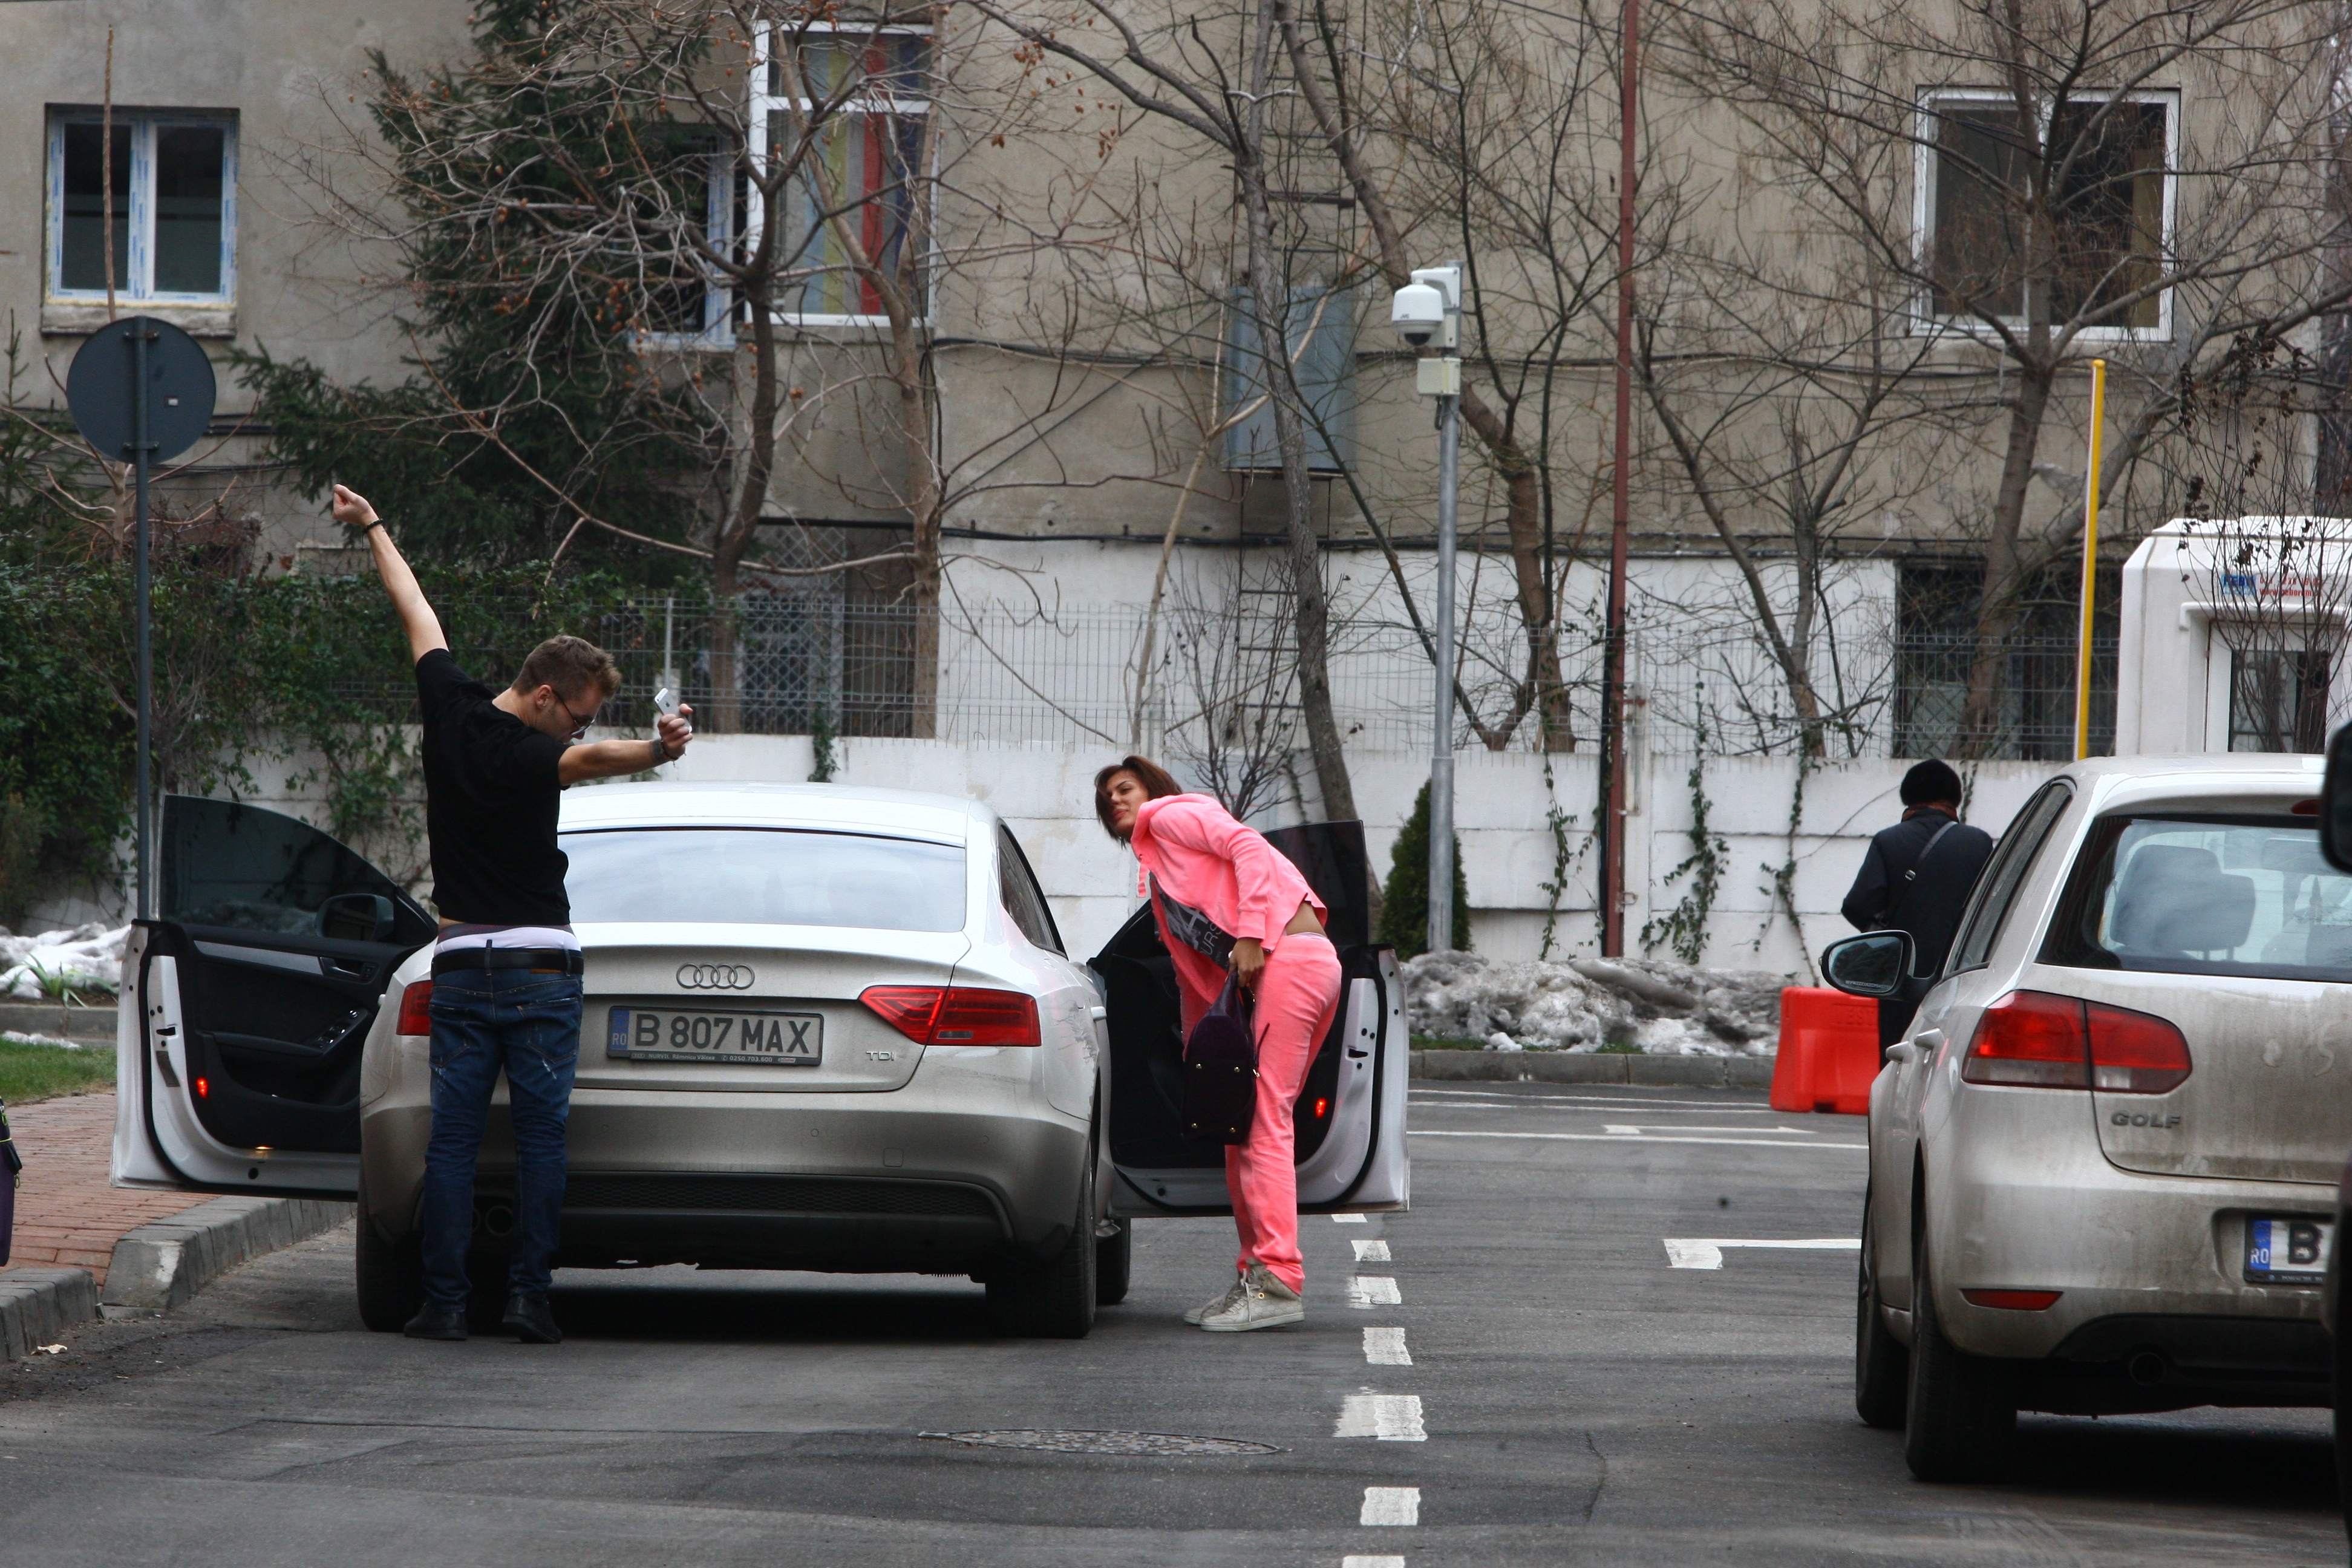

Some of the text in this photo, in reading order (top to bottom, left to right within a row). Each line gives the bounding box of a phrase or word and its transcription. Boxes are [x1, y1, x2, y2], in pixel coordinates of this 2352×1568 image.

[612, 1014, 811, 1053] RO B 807 MAX
[866, 1051, 895, 1061] TDI
[2111, 1111, 2181, 1128] GOLF
[2250, 1222, 2323, 1264] RO B
